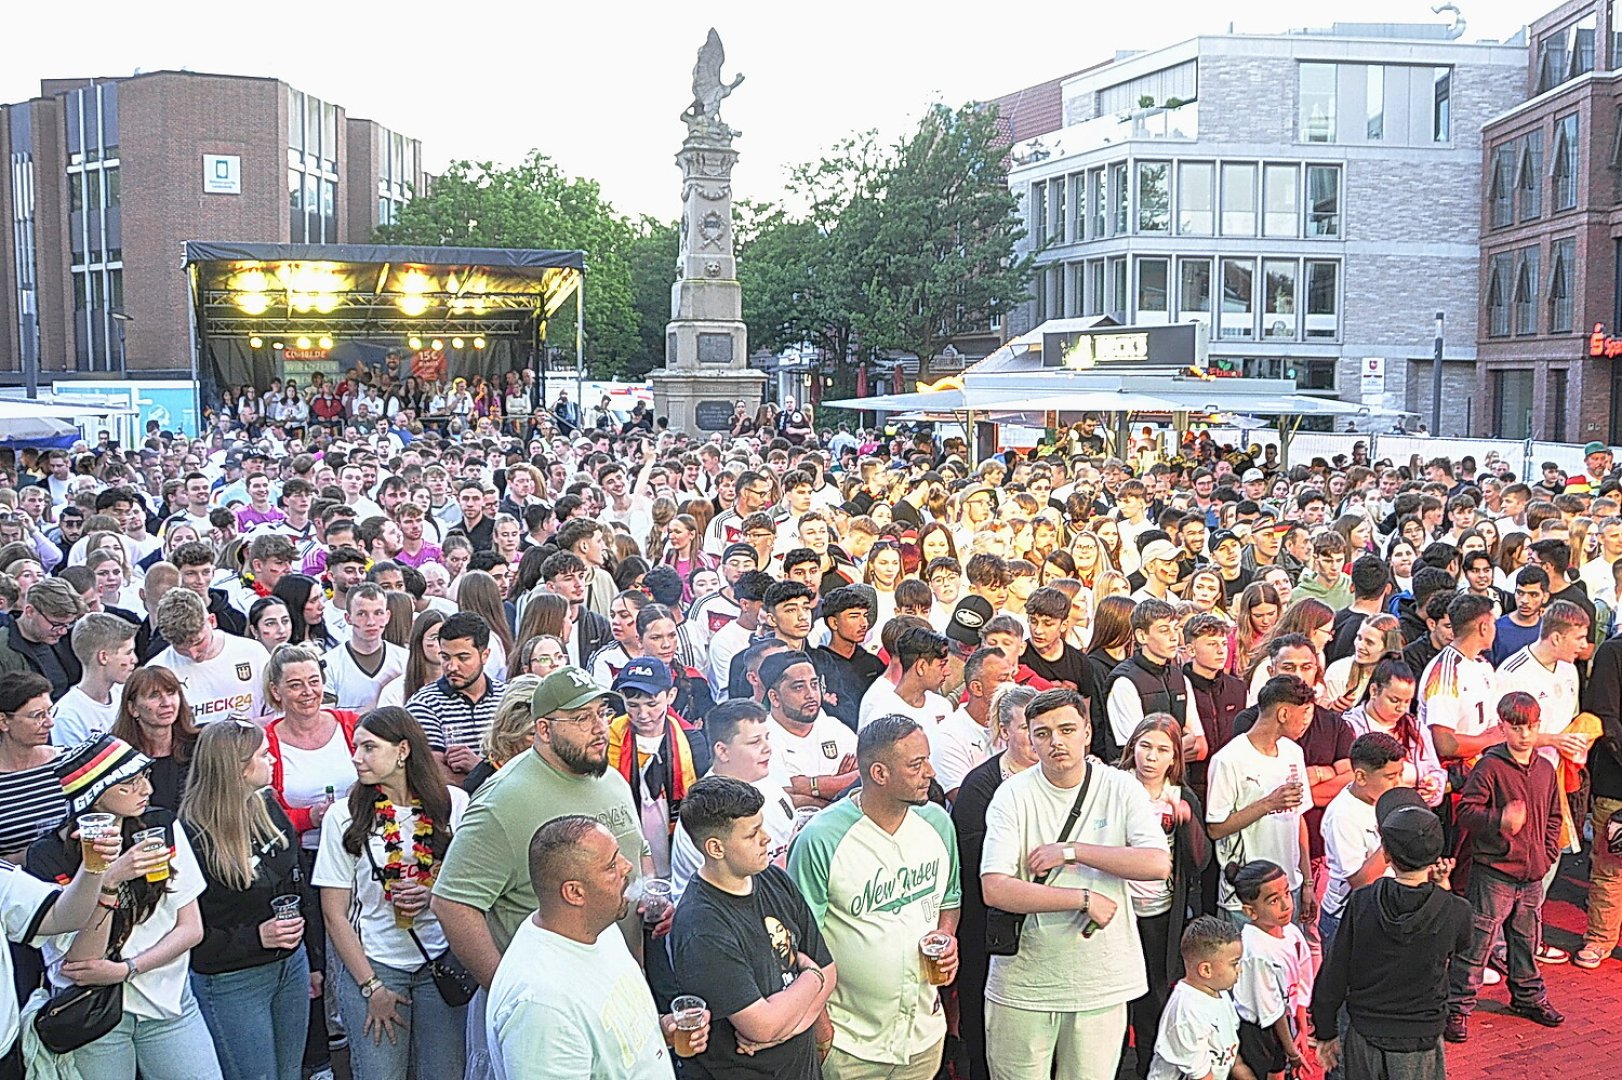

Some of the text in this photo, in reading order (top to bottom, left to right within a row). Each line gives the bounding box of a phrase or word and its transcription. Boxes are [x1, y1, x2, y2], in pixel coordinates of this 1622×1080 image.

[628, 666, 652, 676] FILA
[1475, 701, 1484, 724] 1
[851, 867, 896, 917] New
